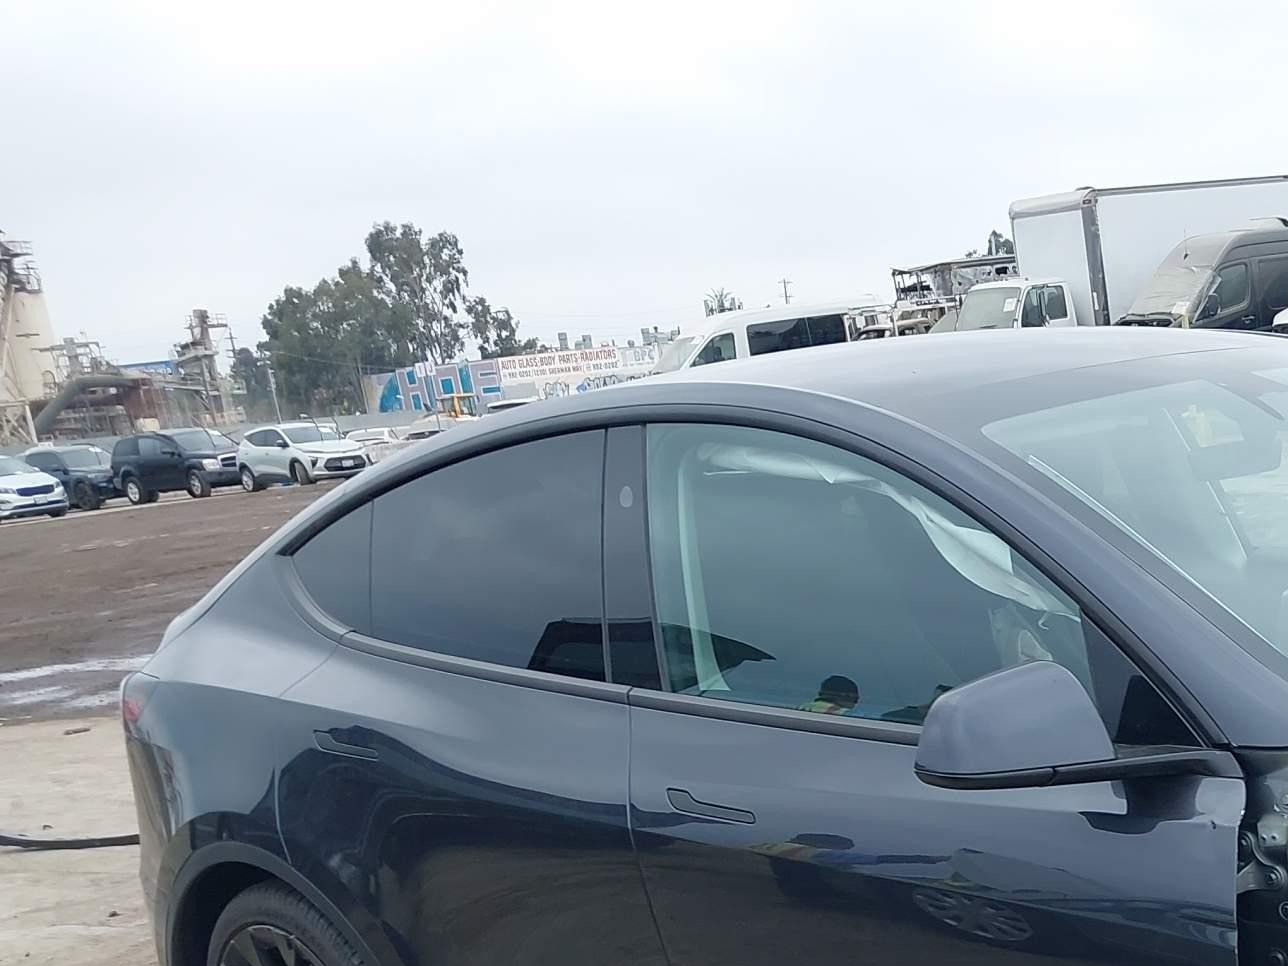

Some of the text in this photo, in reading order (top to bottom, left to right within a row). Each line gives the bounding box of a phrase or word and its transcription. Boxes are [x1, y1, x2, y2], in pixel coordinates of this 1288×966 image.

[501, 359, 517, 370] AUTO
[558, 352, 578, 365] PARTS
[580, 349, 617, 362] RADIATORS
